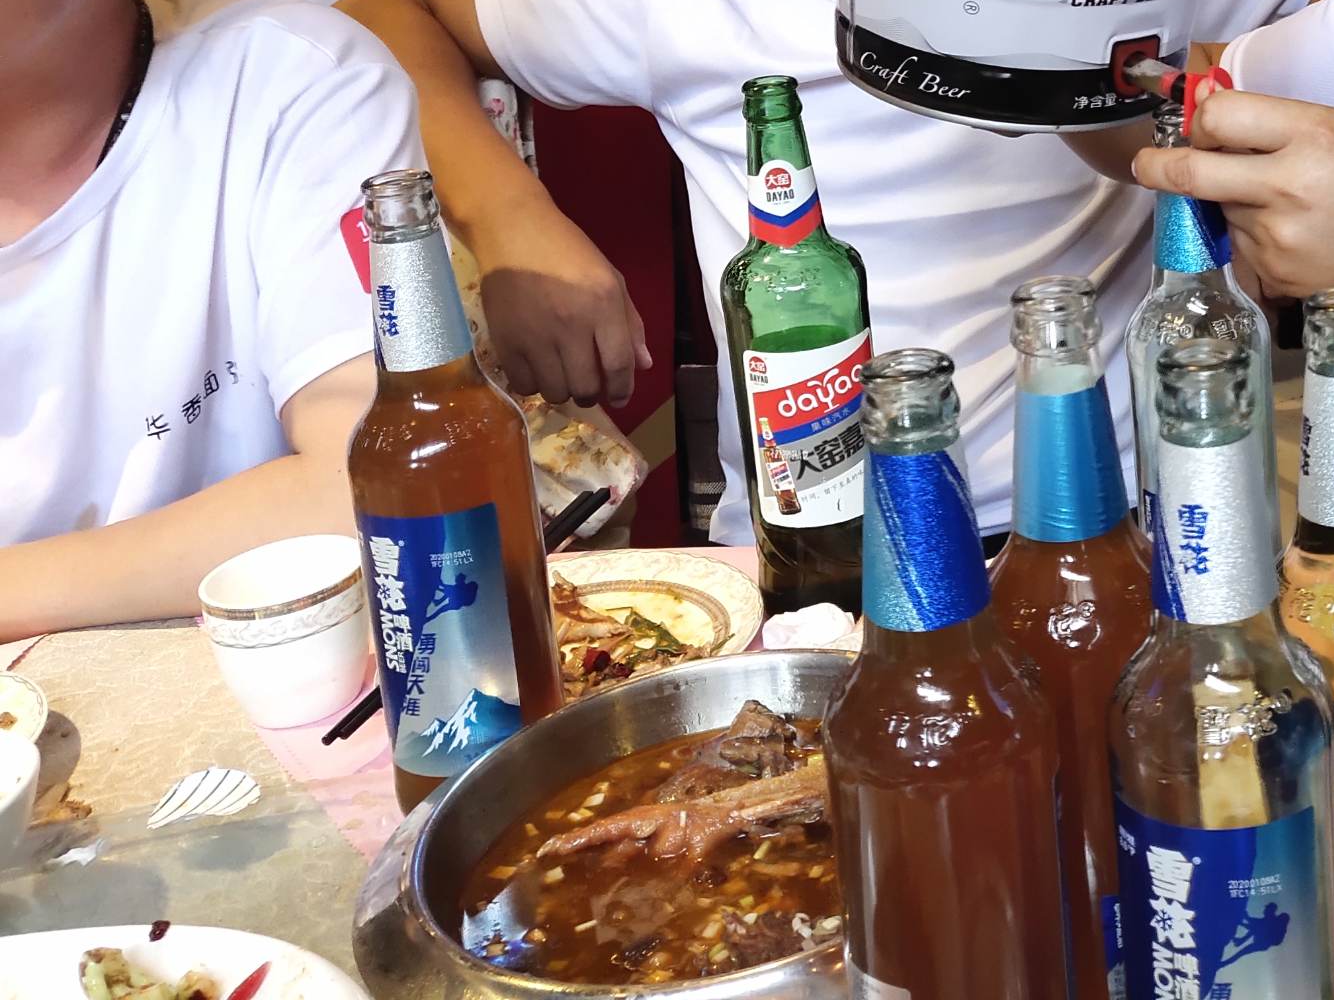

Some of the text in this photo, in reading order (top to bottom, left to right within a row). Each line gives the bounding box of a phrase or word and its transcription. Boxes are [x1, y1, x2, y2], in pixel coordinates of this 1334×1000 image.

[859, 50, 972, 99] Craft Beer
[766, 188, 795, 203] DAYAO
[369, 535, 408, 612] 雪花
[400, 632, 437, 717] 勇闯天涯
[1146, 845, 1197, 949] 雪花
